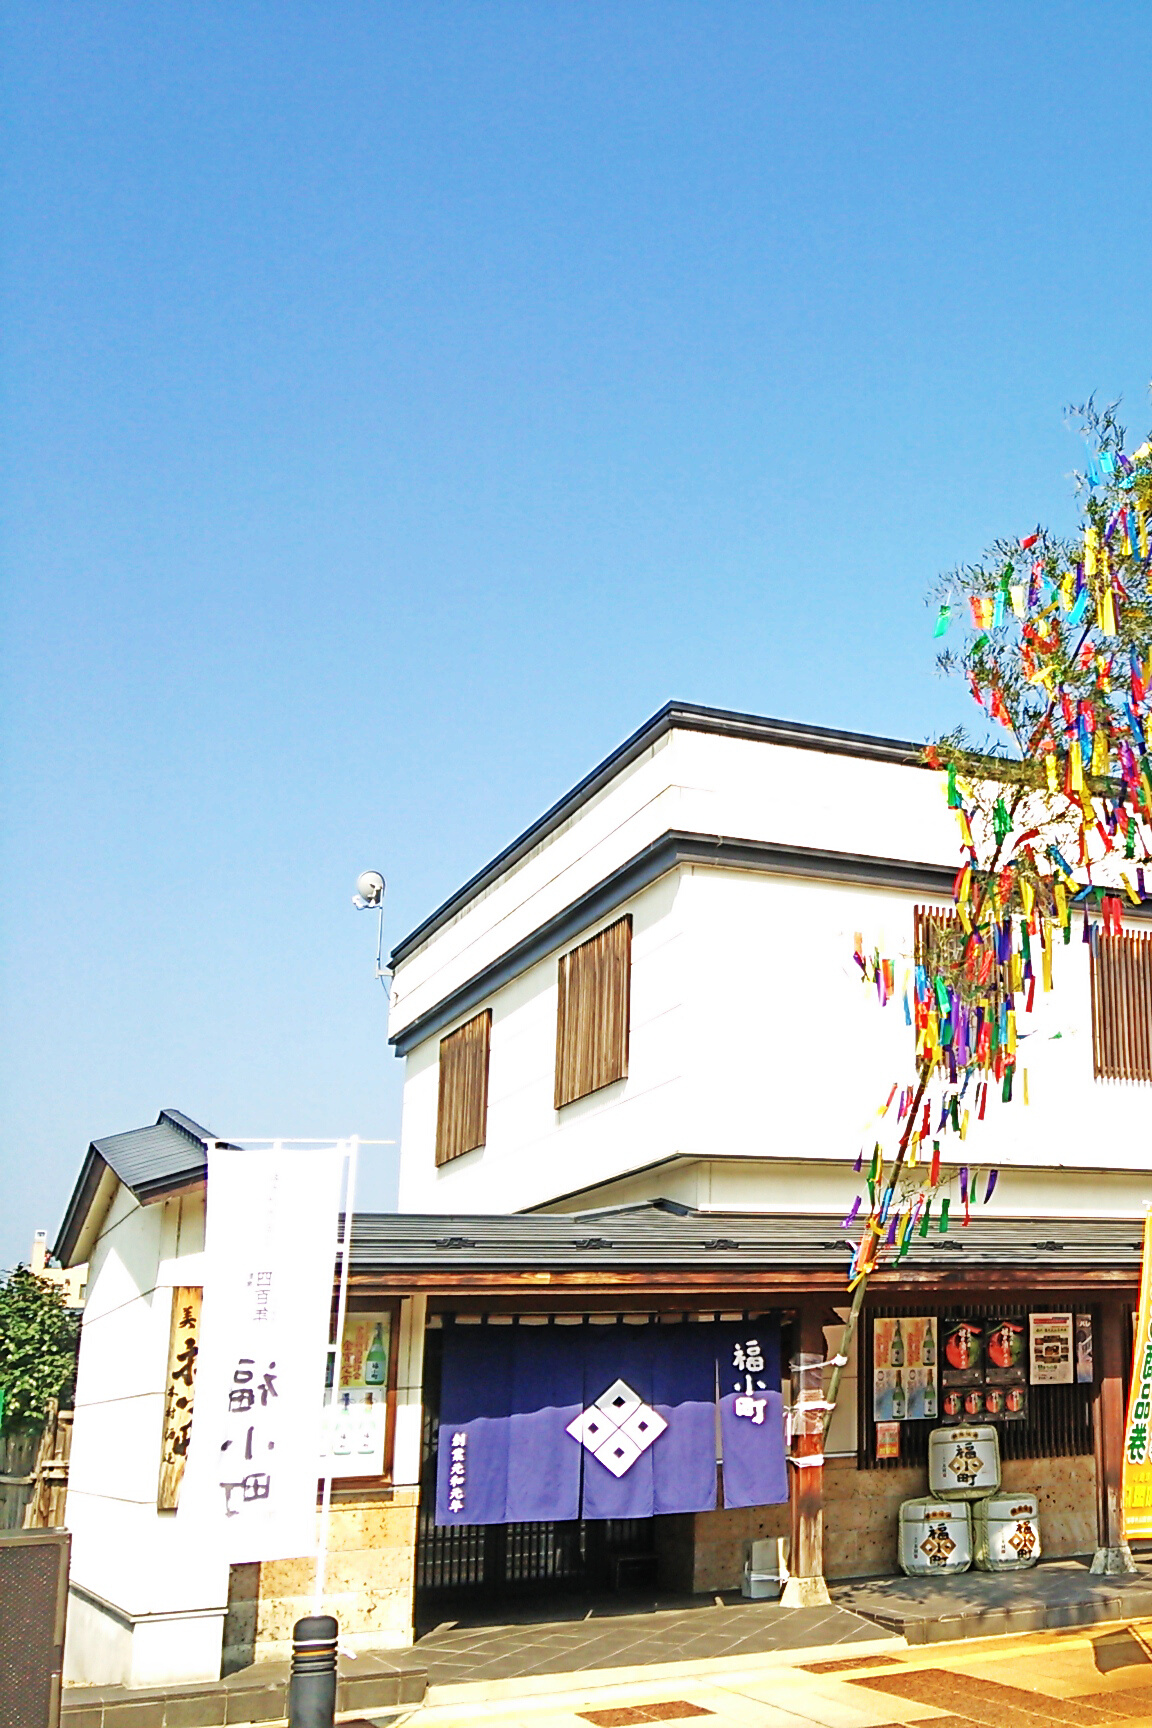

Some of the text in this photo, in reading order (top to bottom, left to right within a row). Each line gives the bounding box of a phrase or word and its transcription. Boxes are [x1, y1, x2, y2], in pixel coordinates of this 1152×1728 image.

[733, 1339, 766, 1424] 福小町
[448, 1432, 466, 1513] 創業元和元年
[956, 1442, 977, 1486] 福小町
[928, 1523, 949, 1567] 福小町
